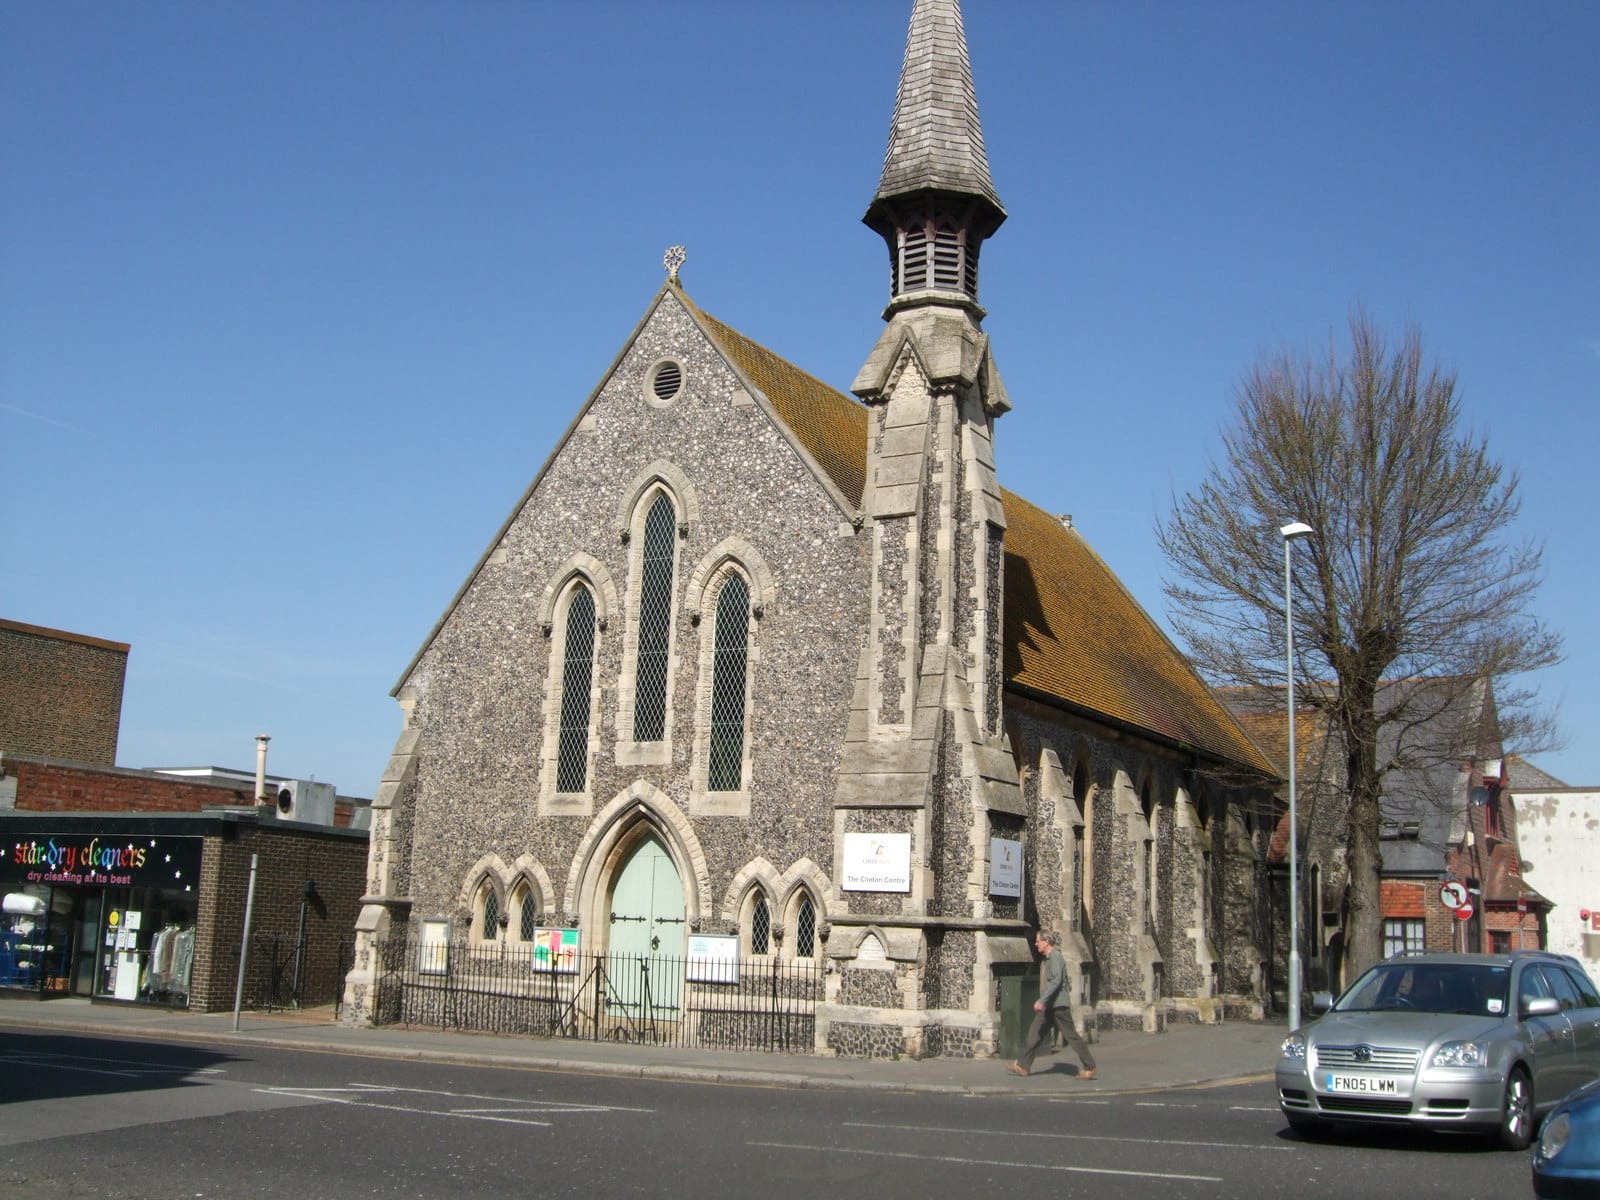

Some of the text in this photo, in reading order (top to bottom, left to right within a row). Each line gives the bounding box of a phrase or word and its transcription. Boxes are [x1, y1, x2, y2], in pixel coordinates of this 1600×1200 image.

[15, 841, 45, 865] star
[80, 838, 146, 868] cleaners
[27, 871, 131, 884] dry cleaning at its best
[1335, 1077, 1395, 1092] FN05 LWM
